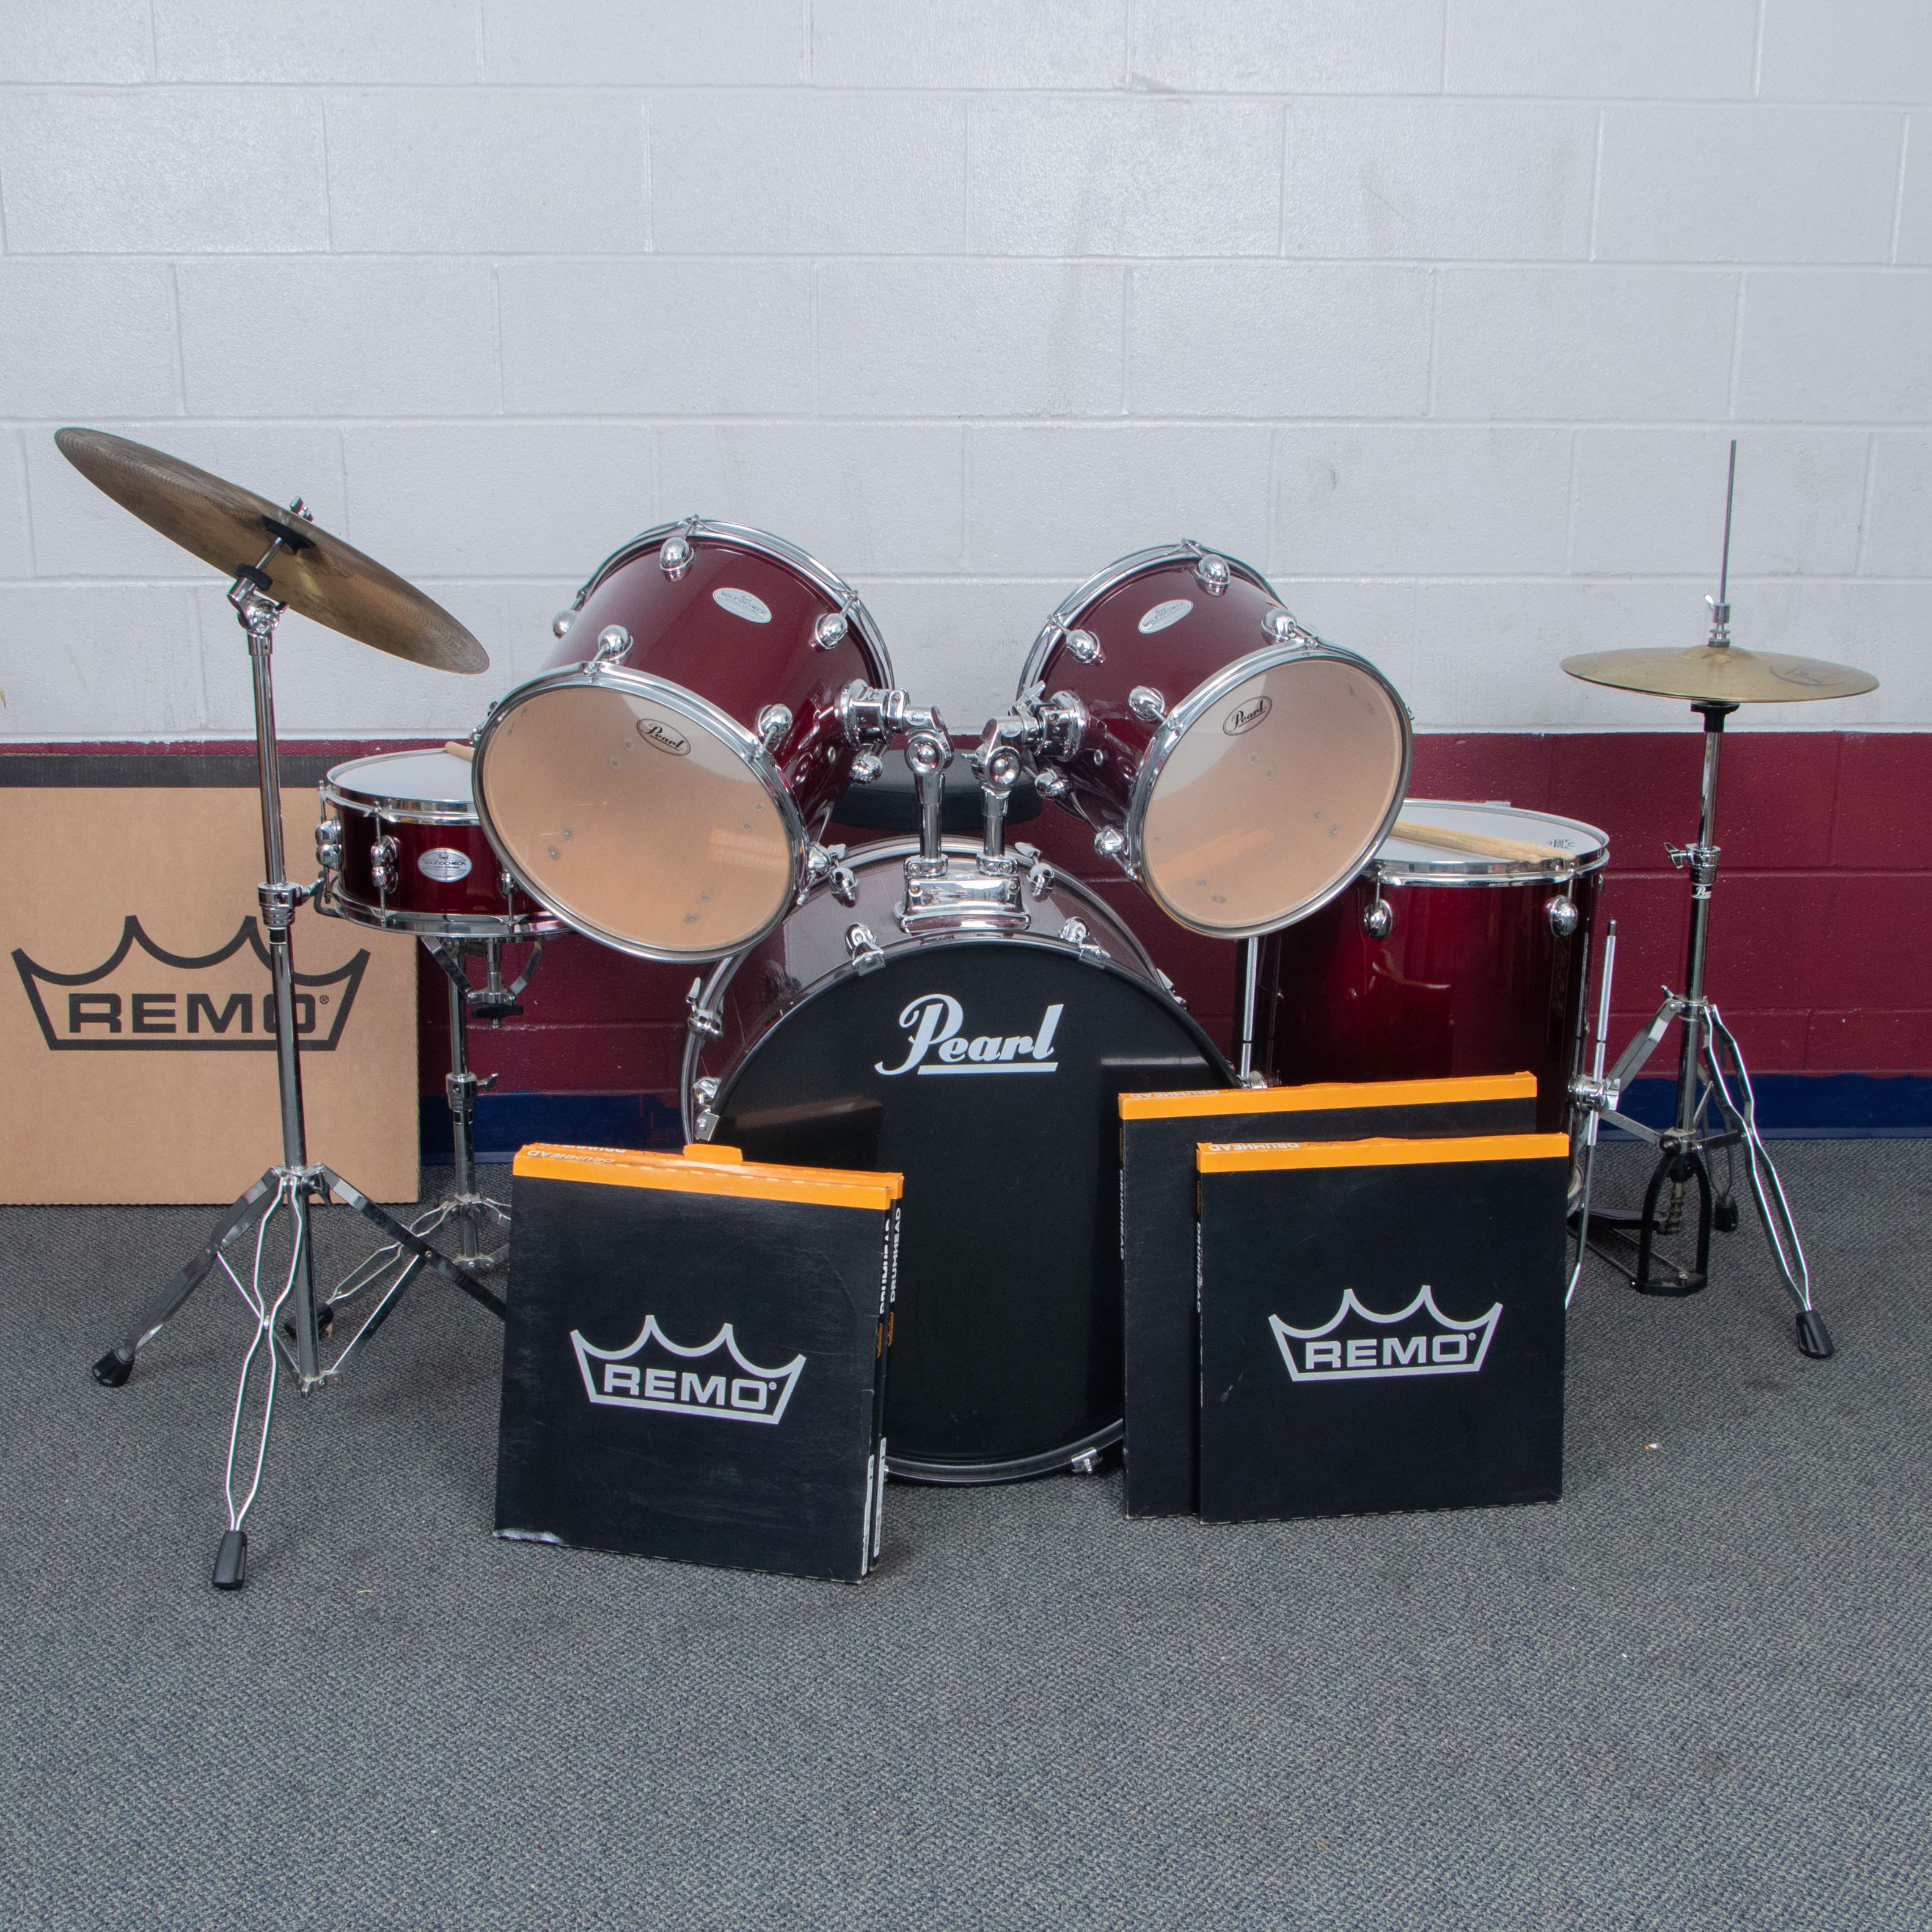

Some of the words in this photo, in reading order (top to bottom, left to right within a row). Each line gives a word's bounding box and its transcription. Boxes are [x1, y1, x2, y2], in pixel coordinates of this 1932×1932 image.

[1229, 700, 1264, 732] Pearl
[640, 723, 685, 748] Pearl
[69, 993, 316, 1033] REMO
[874, 994, 1064, 1075] Pearl
[527, 1150, 616, 1163] DRUMHEAD
[1208, 1143, 1300, 1151] DRUMHEAD
[890, 1207, 901, 1303] DRUMHEAD
[1305, 1334, 1468, 1369] REMO
[604, 1364, 767, 1410] REMO
